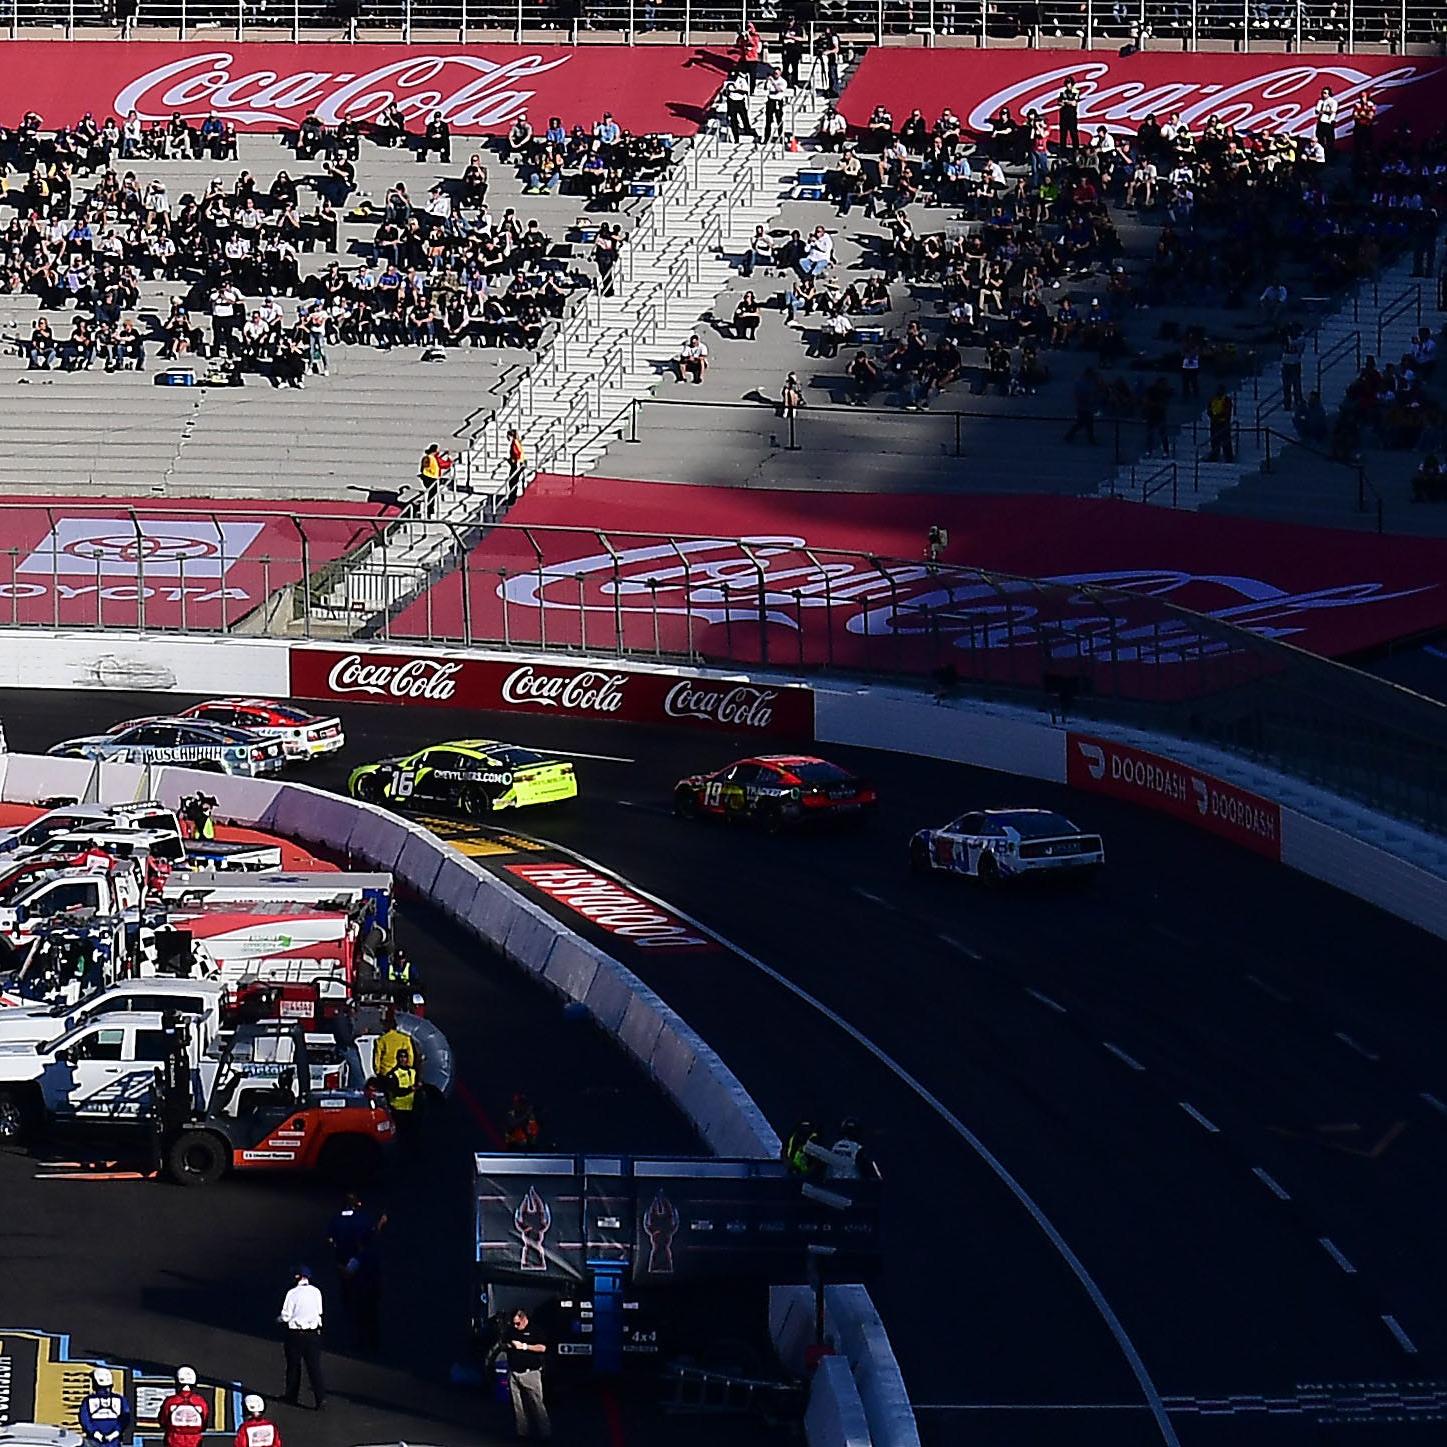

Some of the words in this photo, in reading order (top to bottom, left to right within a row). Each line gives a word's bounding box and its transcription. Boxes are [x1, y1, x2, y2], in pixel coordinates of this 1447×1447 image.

[114, 52, 572, 127] Coca-Cola
[496, 536, 1439, 664] Coca-Cola
[328, 654, 463, 700] Coca-Cola
[502, 665, 634, 713] Coca-Cola
[664, 679, 778, 728] Coca-Cola
[390, 770, 414, 796] 16
[704, 781, 722, 806] 19
[1111, 753, 1187, 802] DOORDASH
[1211, 788, 1275, 839] DOORDASH
[521, 868, 707, 947] DOORDASH
